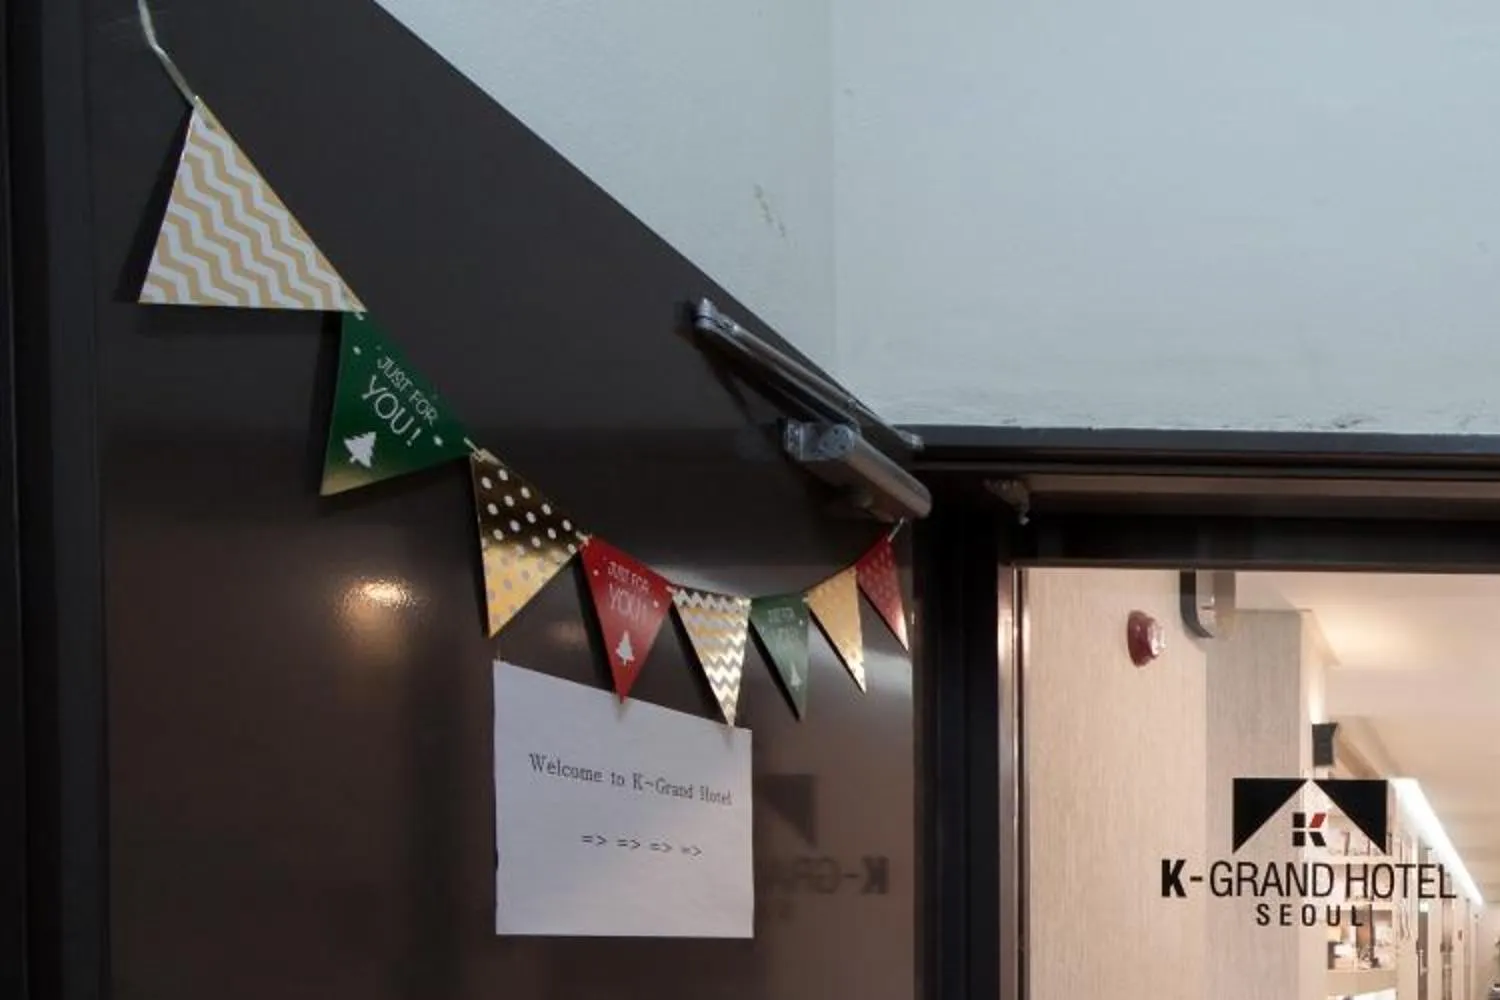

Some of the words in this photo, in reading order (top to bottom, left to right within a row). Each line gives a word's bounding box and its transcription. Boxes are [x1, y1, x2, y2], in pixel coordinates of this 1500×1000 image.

[362, 374, 422, 447] YOU!
[377, 356, 413, 391] JUST
[409, 390, 438, 426] FOR
[528, 752, 603, 783] Welcome
[610, 770, 626, 787] to
[632, 772, 694, 801] K-Grand
[699, 784, 734, 807] Hotel
[1345, 862, 1458, 899] HOTEL
[1256, 903, 1365, 927] SEOUL
